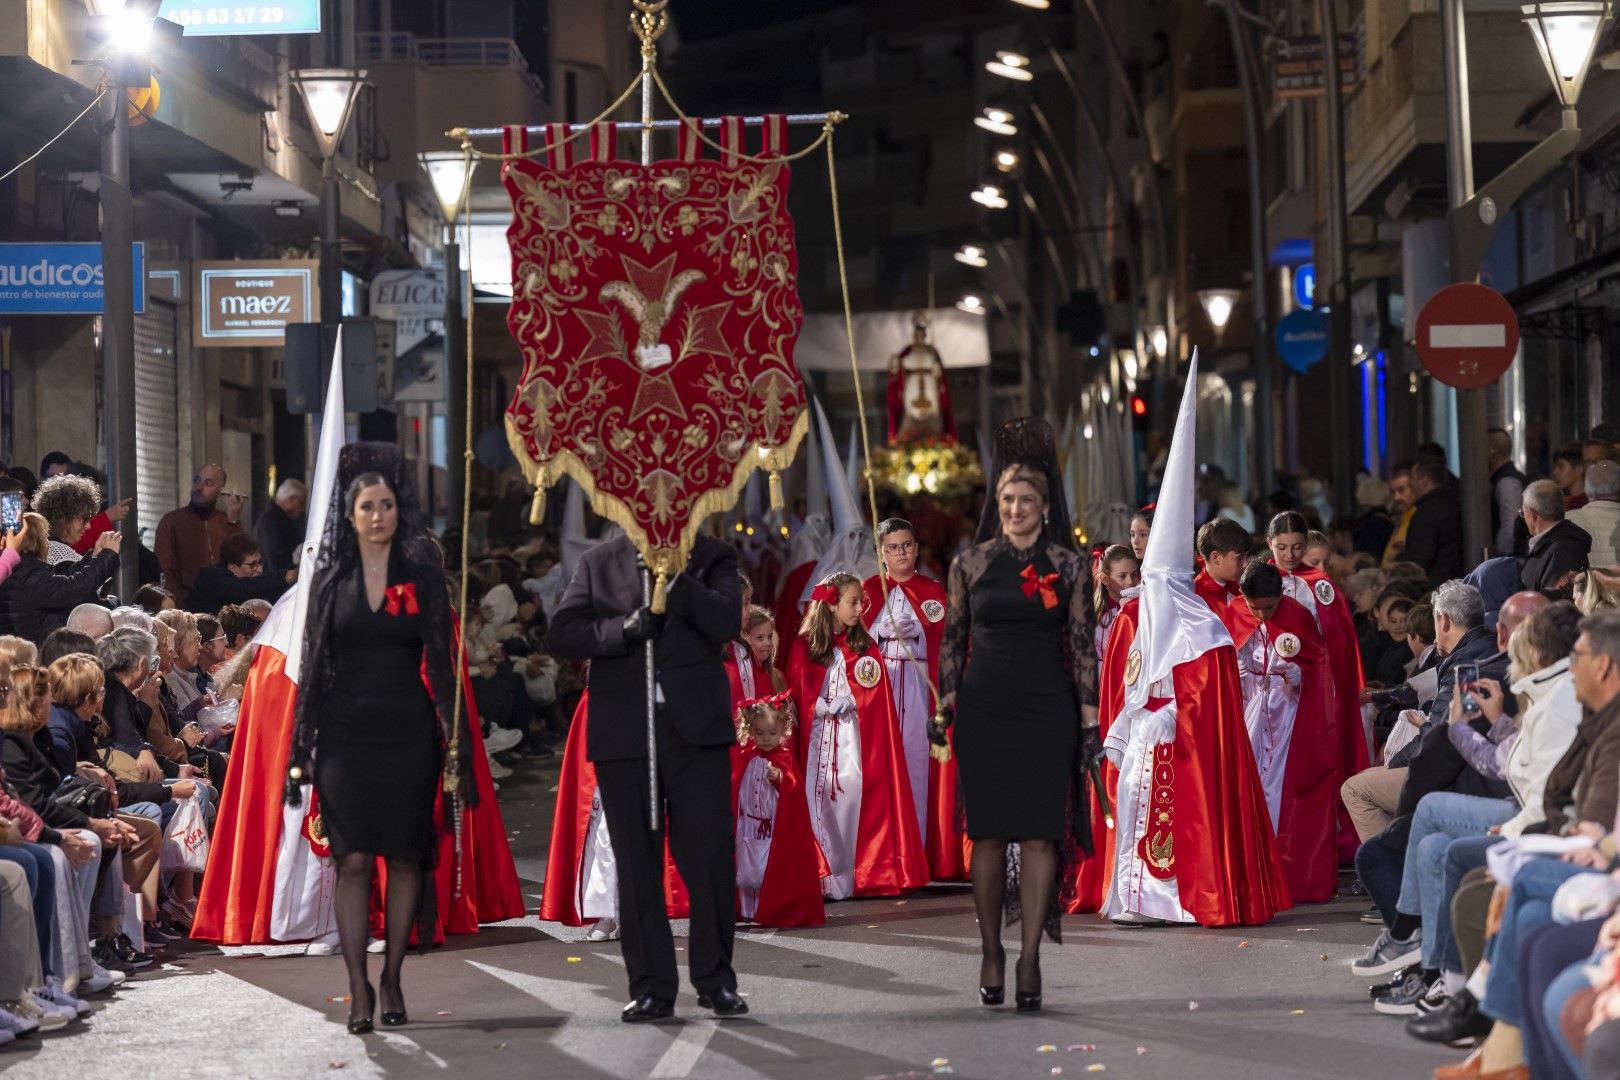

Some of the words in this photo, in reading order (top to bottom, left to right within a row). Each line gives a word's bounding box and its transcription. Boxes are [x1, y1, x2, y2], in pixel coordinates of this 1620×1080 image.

[168, 9, 203, 25] 656
[206, 8, 229, 24] 63
[233, 7, 257, 24] 17
[260, 6, 284, 23] 29
[22, 285, 33, 298] de
[35, 285, 80, 298] bienestar
[220, 295, 292, 315] maez
